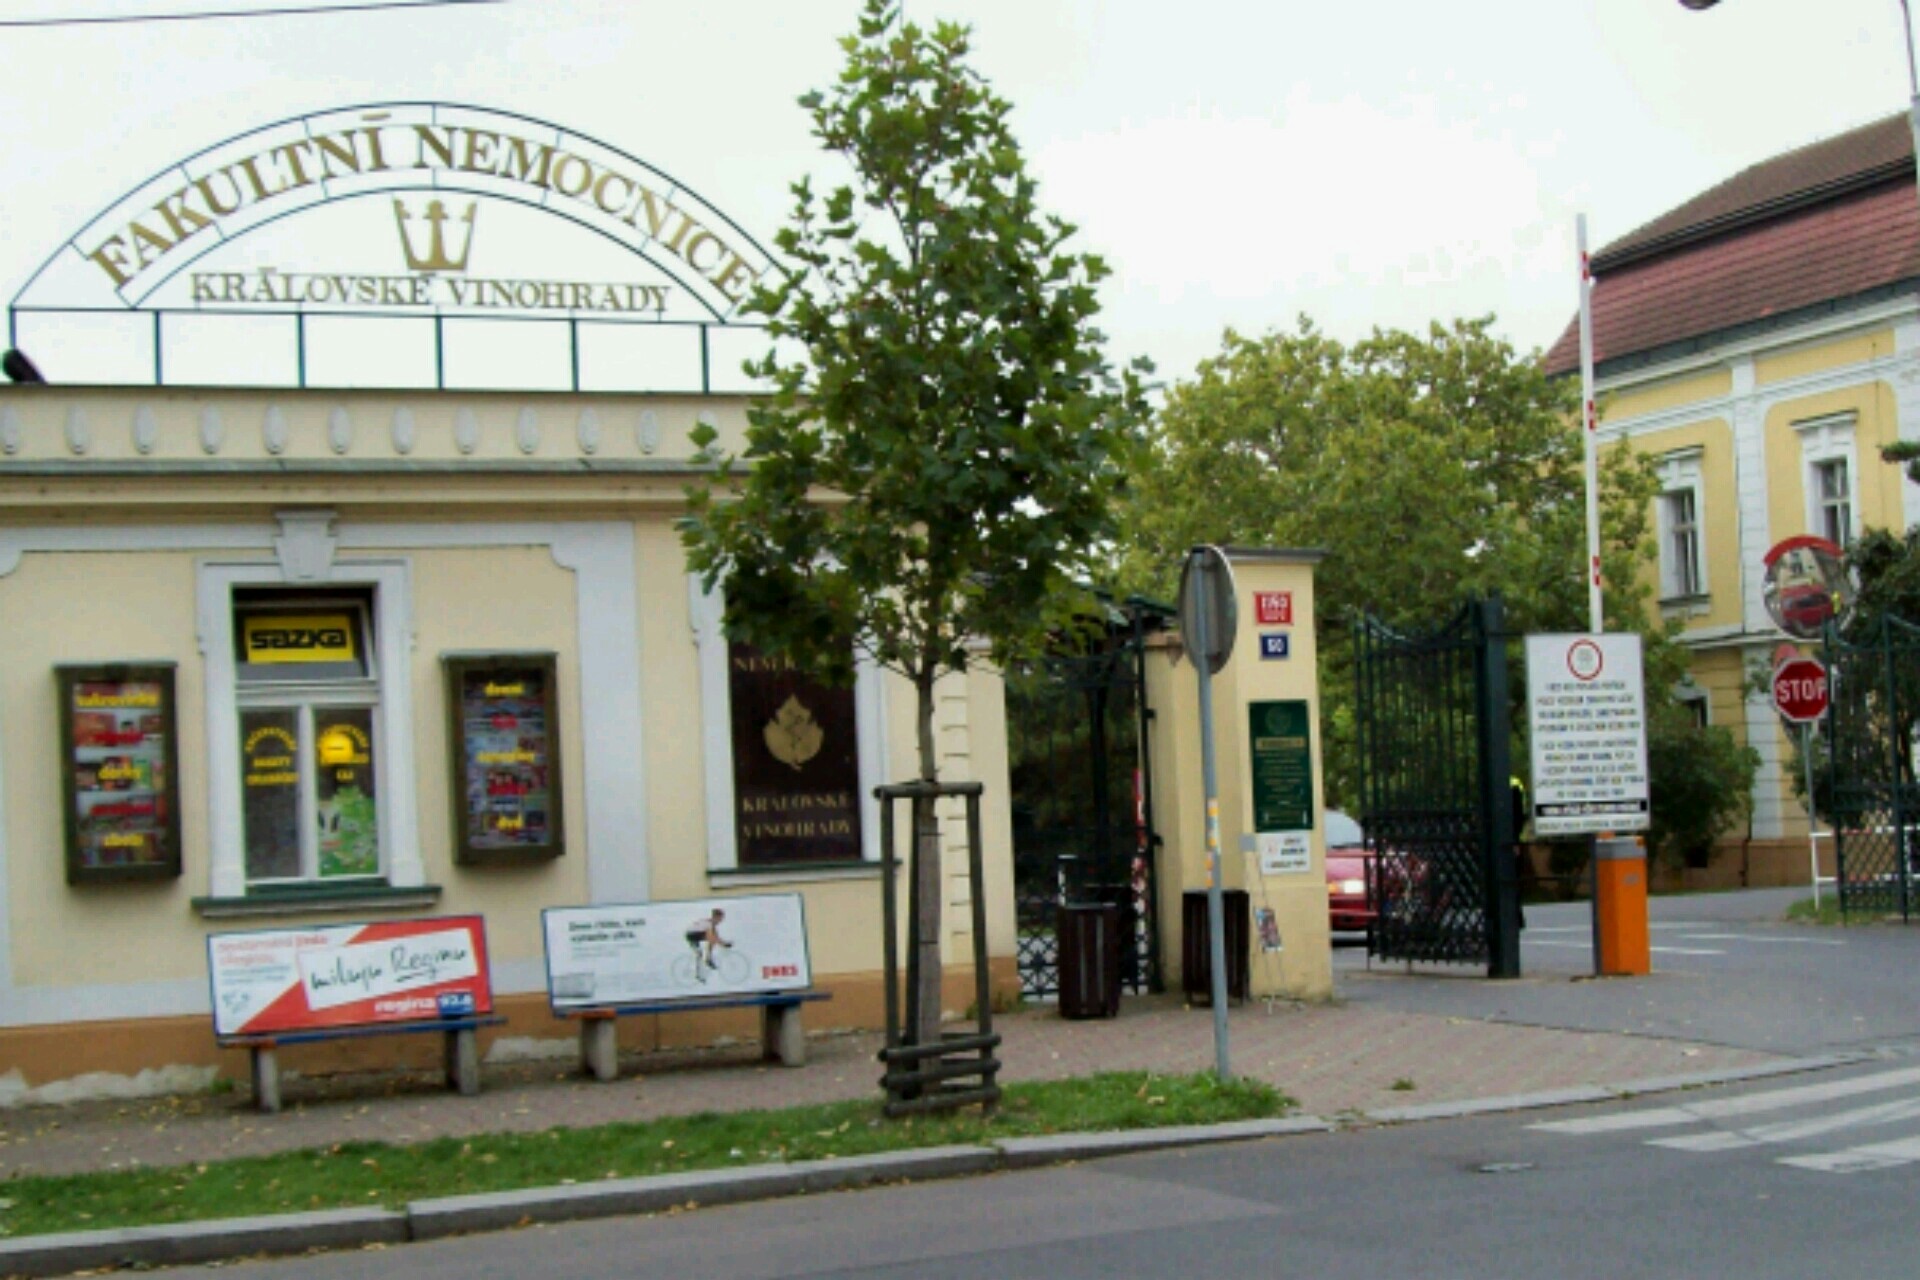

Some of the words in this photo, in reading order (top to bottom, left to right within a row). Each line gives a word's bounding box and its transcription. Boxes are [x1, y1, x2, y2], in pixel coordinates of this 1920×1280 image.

[88, 113, 391, 287] FAKULTNÍ
[412, 124, 761, 305] NEMOCNICE
[190, 267, 437, 305] KRÁLOVSKÉ
[446, 278, 671, 312] VINOHRADY
[1776, 677, 1827, 703] STOP
